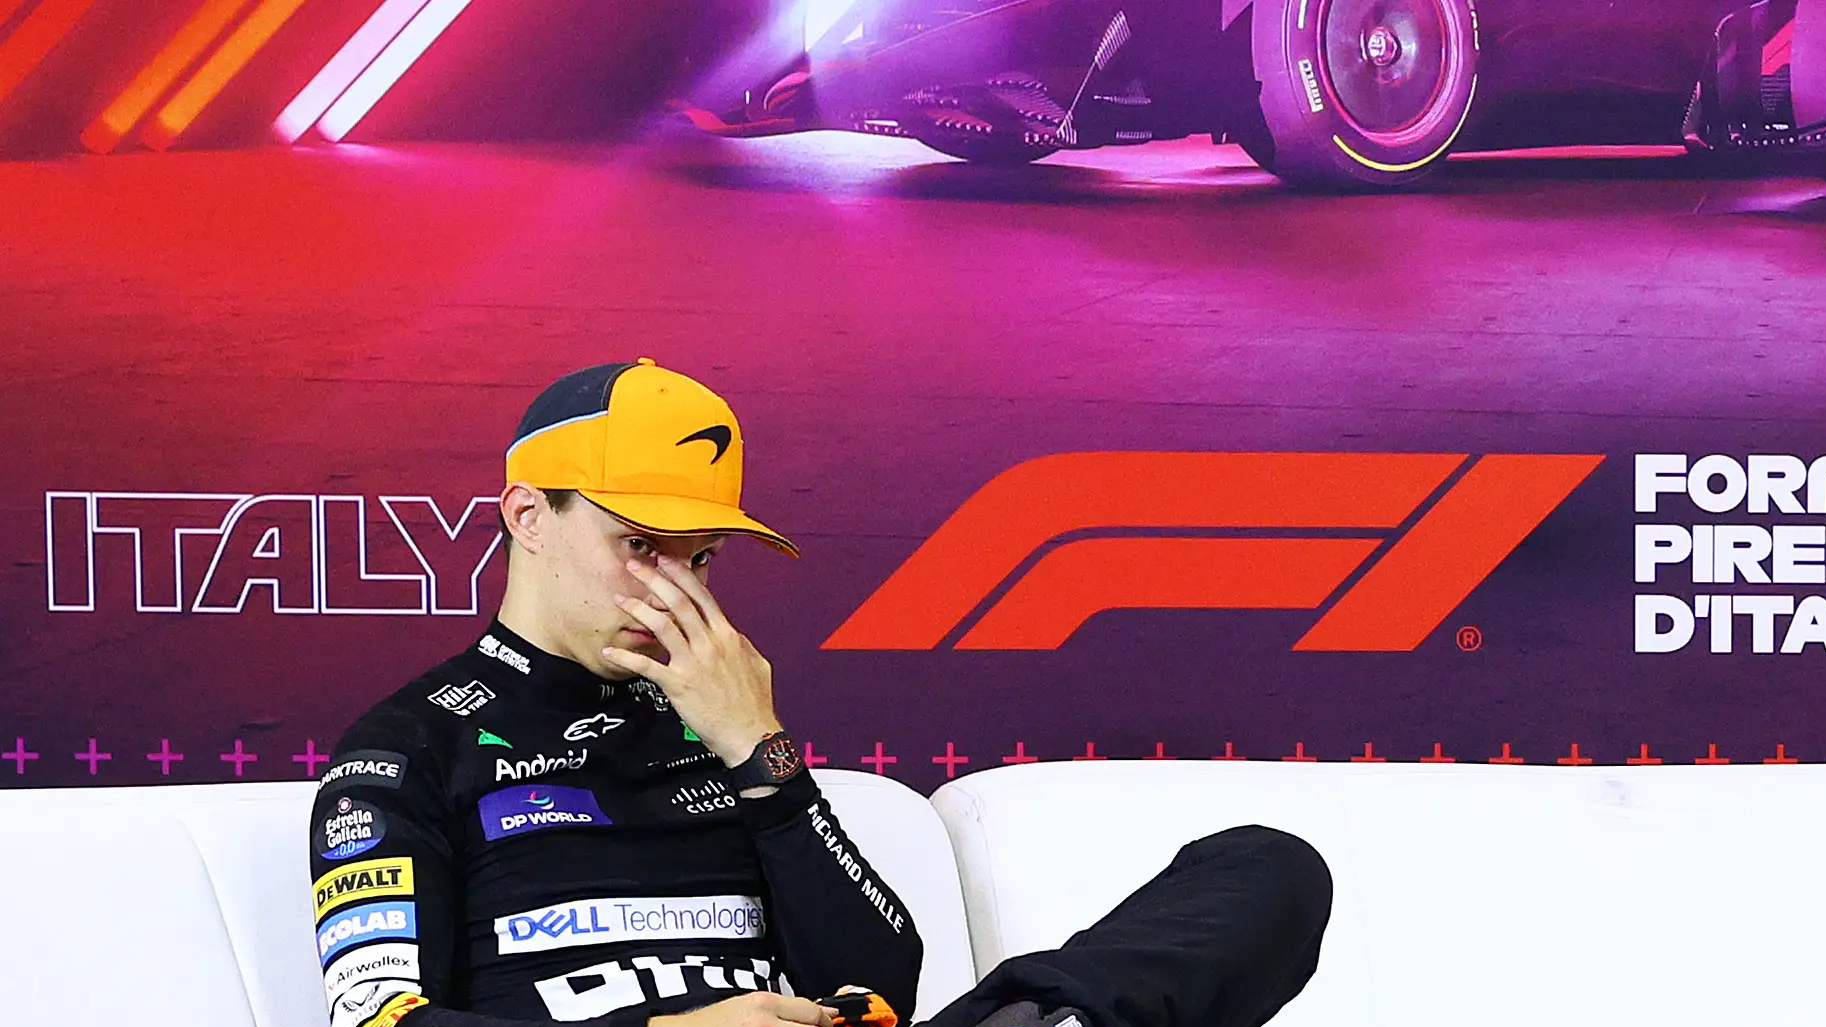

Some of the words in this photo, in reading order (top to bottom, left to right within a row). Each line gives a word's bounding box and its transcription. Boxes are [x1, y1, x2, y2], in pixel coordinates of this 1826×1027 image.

[46, 491, 503, 615] ITALY
[819, 451, 1608, 652] F1
[495, 749, 588, 781] Android
[686, 795, 736, 814] CISCO
[326, 810, 373, 835] Estrella
[328, 824, 372, 848] Galicia
[500, 814, 528, 831] DP
[529, 811, 593, 826] WORLD
[808, 803, 863, 883] RICHARD
[861, 878, 905, 934] MILLE
[508, 905, 611, 942] DELL
[613, 902, 762, 935] Technologie
[337, 955, 411, 986] Airwallex
